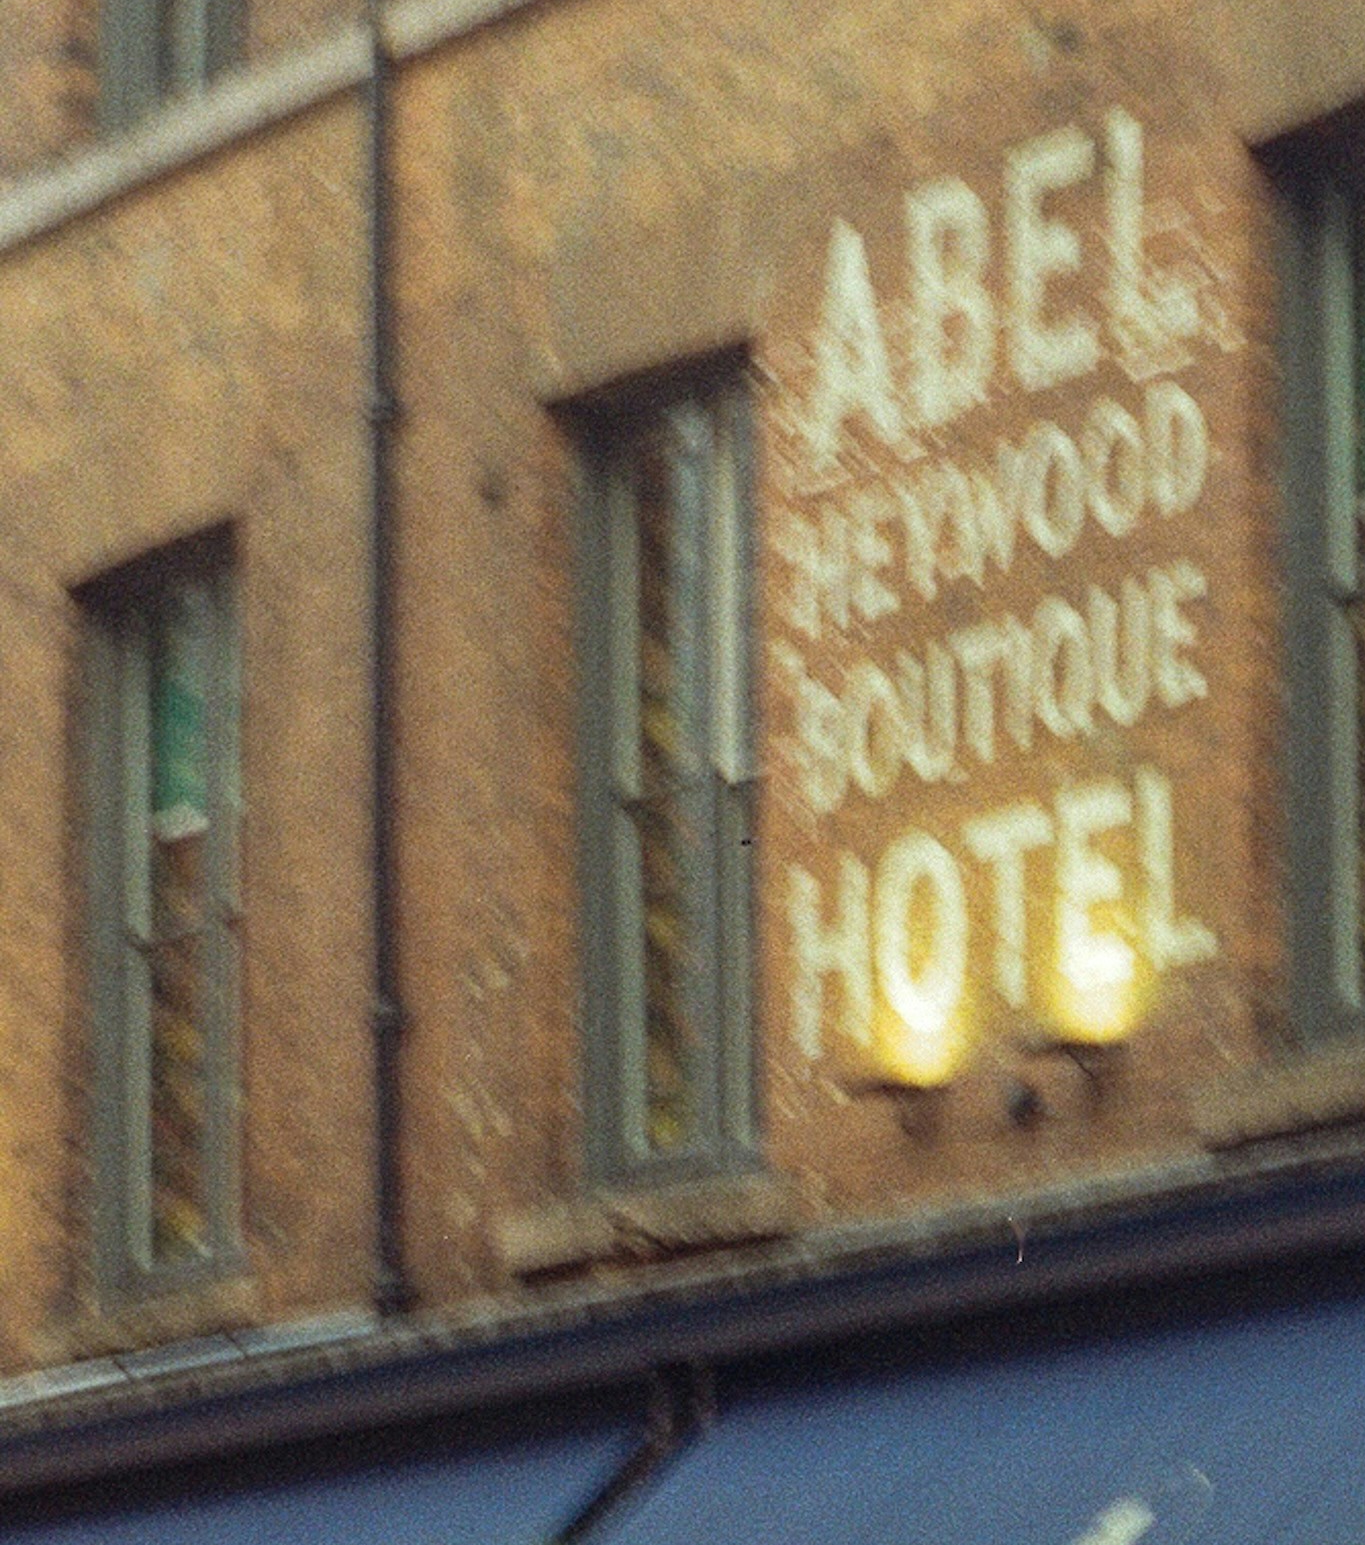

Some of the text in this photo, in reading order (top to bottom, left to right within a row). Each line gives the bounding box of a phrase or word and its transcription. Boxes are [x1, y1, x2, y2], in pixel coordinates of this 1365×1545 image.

[808, 104, 1204, 468] ABEL
[782, 381, 1204, 638] HEYWOOD
[784, 559, 1206, 816] BOUTIQUE
[786, 765, 1218, 1058] HOTEL
